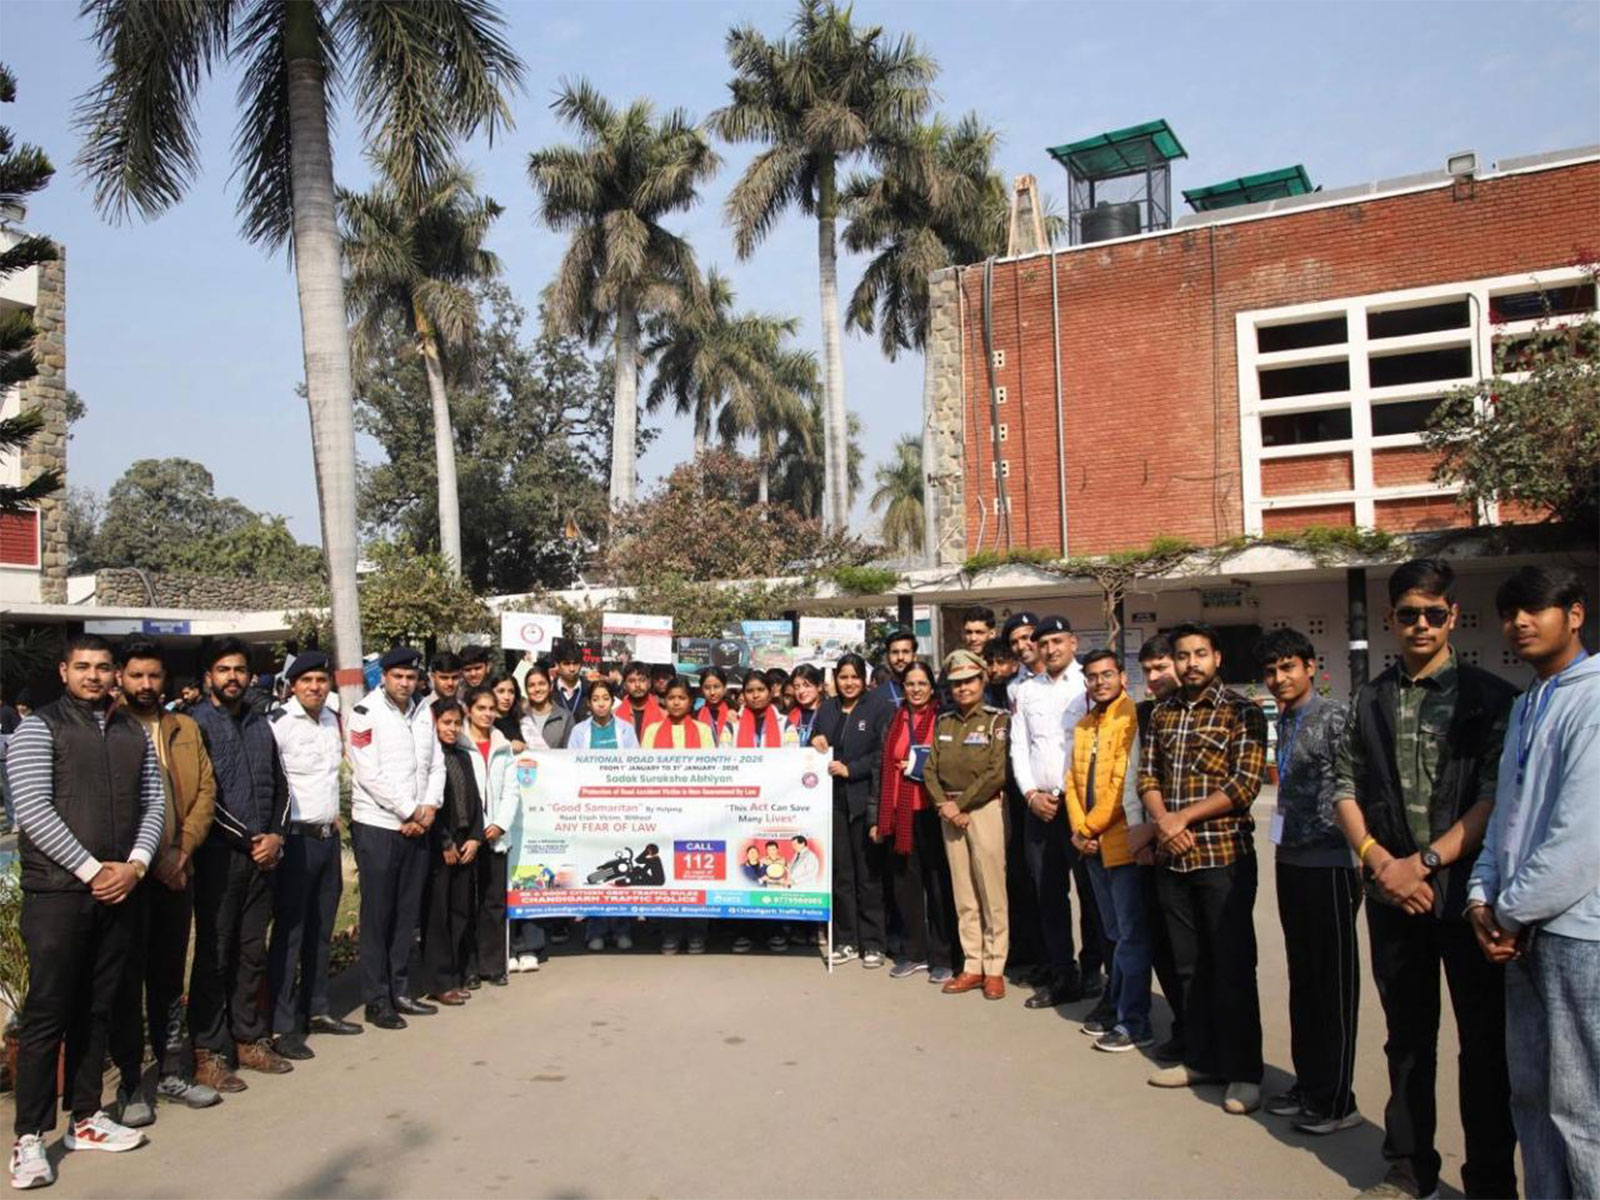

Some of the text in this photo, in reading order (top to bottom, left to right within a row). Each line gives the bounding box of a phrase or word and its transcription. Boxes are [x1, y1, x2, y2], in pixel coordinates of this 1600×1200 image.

[576, 756, 623, 764] NATIONAL
[750, 802, 769, 812] Act
[771, 804, 788, 812] Can
[790, 804, 811, 812] Save
[738, 815, 762, 824] Many
[554, 822, 658, 832] ANY FEAR OF LAW
[686, 842, 714, 850] CALL
[683, 854, 715, 869] 112
[736, 907, 778, 915] Chandigarh
